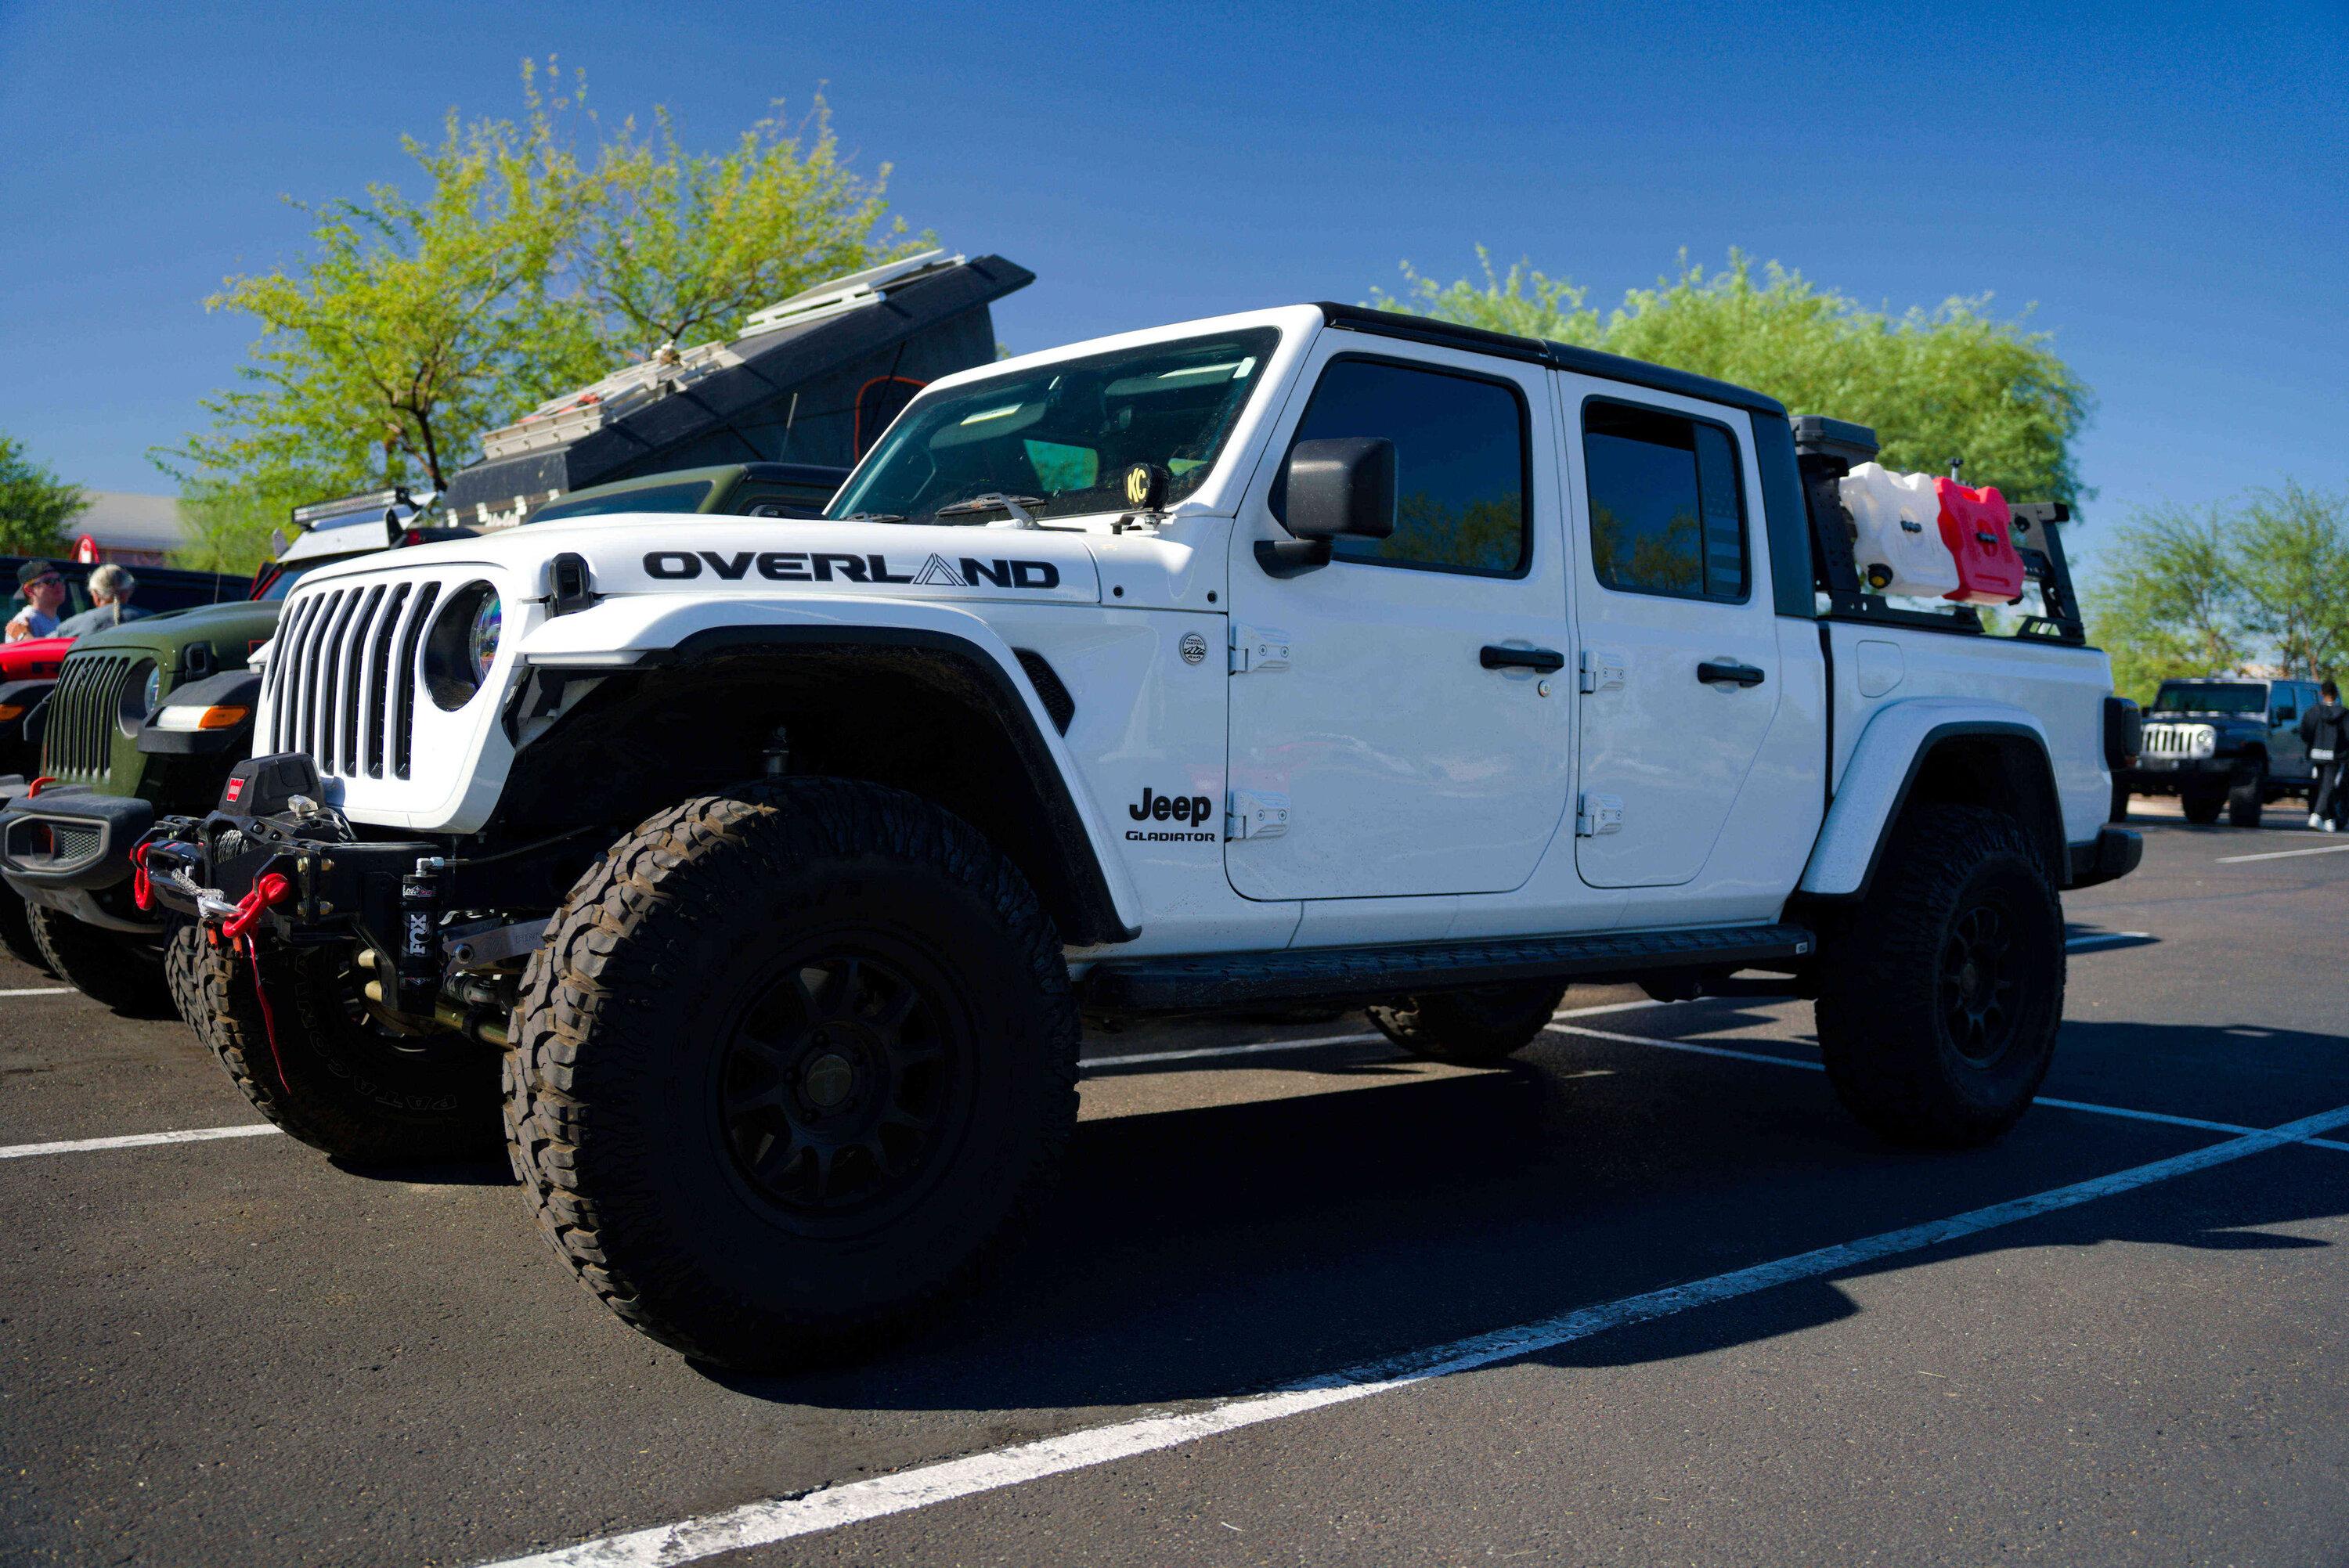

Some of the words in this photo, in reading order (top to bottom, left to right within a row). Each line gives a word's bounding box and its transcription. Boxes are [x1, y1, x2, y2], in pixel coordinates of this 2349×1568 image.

[1128, 467, 1146, 503] KC
[643, 550, 1059, 589] OVERLAND
[1129, 787, 1211, 827] Jeep
[1125, 831, 1216, 842] GLADIATOR
[409, 914, 428, 955] FOX
